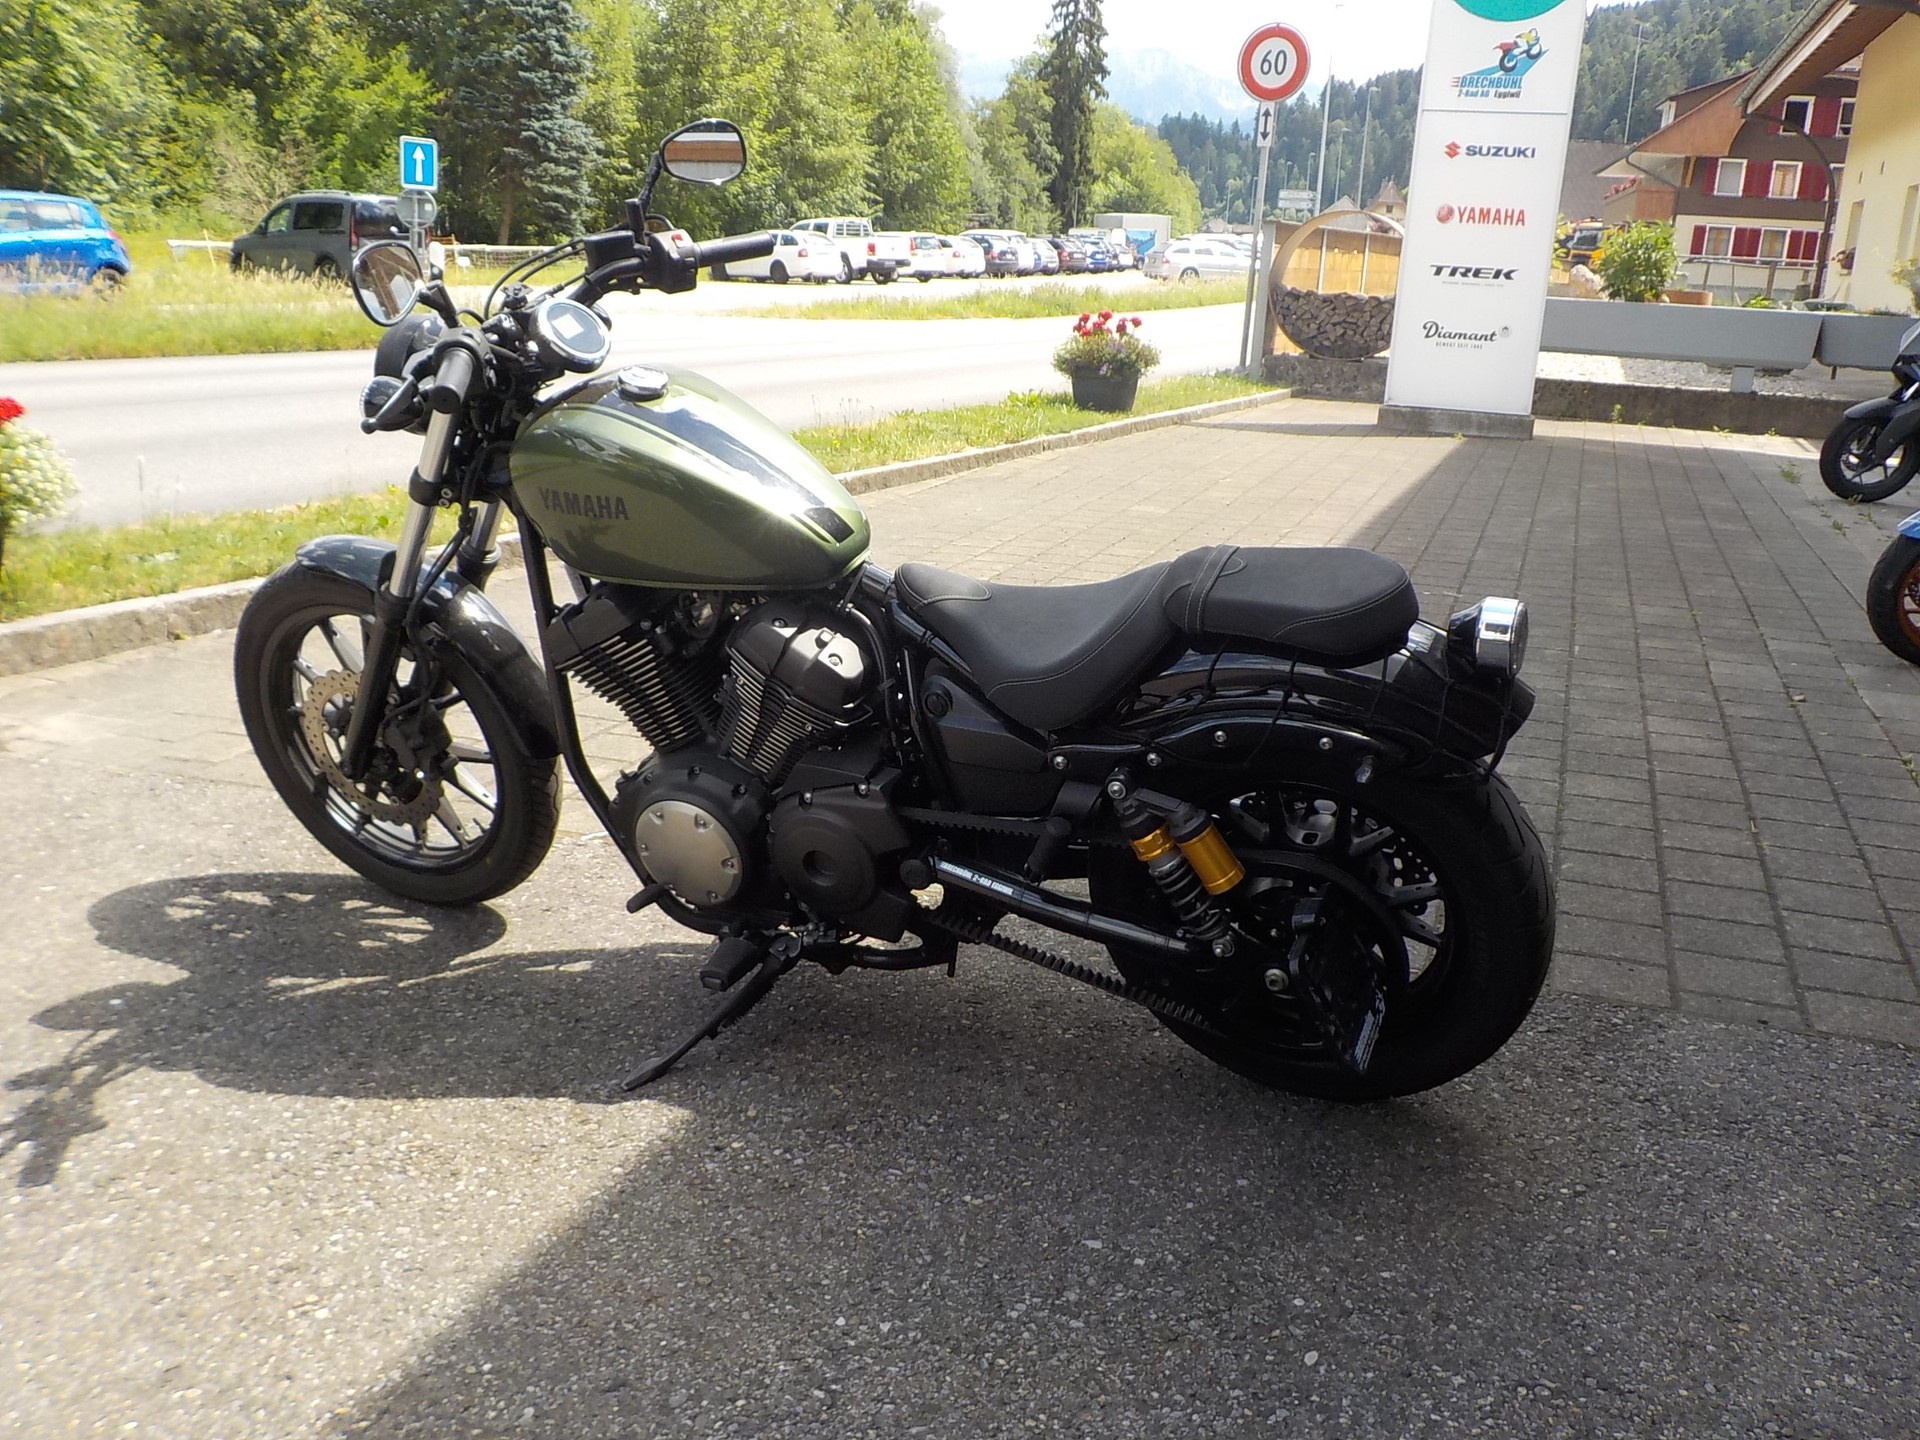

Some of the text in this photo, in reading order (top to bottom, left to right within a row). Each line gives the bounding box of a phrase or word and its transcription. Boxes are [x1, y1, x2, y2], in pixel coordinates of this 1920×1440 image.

[1260, 48, 1287, 76] 60
[1465, 144, 1536, 159] SUZUKI
[1457, 206, 1526, 227] YAMAHA
[1429, 264, 1519, 281] TREK
[1422, 320, 1498, 342] Diamant
[538, 486, 630, 521] YAMAHA
